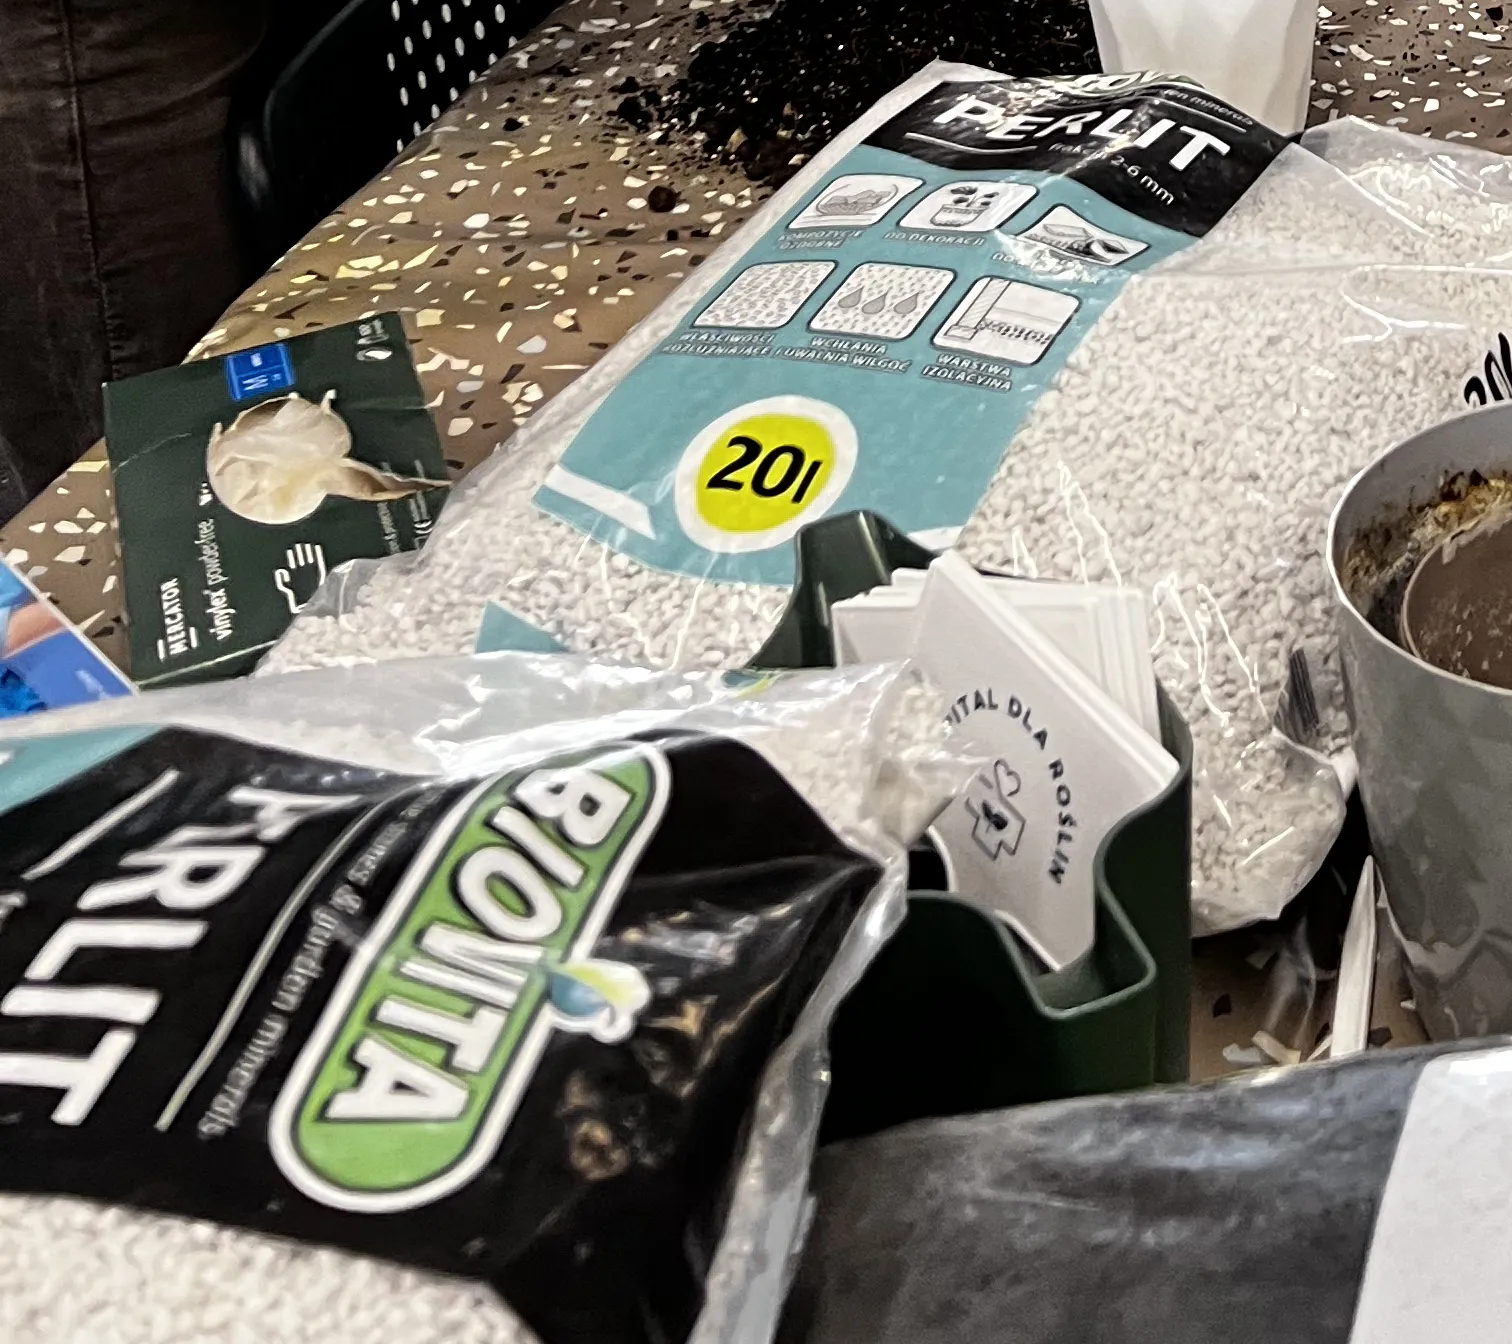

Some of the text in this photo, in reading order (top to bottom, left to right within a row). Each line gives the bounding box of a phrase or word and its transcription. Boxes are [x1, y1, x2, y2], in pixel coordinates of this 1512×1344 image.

[933, 95, 1231, 172] PERLIT
[1111, 155, 1141, 178] 2-6
[1140, 174, 1176, 206] mm
[904, 232, 986, 247] DEKORACJI
[922, 364, 1013, 392] IZOLACYJNA
[938, 353, 1012, 378] WARSTWA
[161, 578, 190, 656] MERCATOR
[1007, 694, 1049, 751] DLA
[323, 767, 635, 1121] BIOVITA
[198, 1012, 290, 1140] minerals
